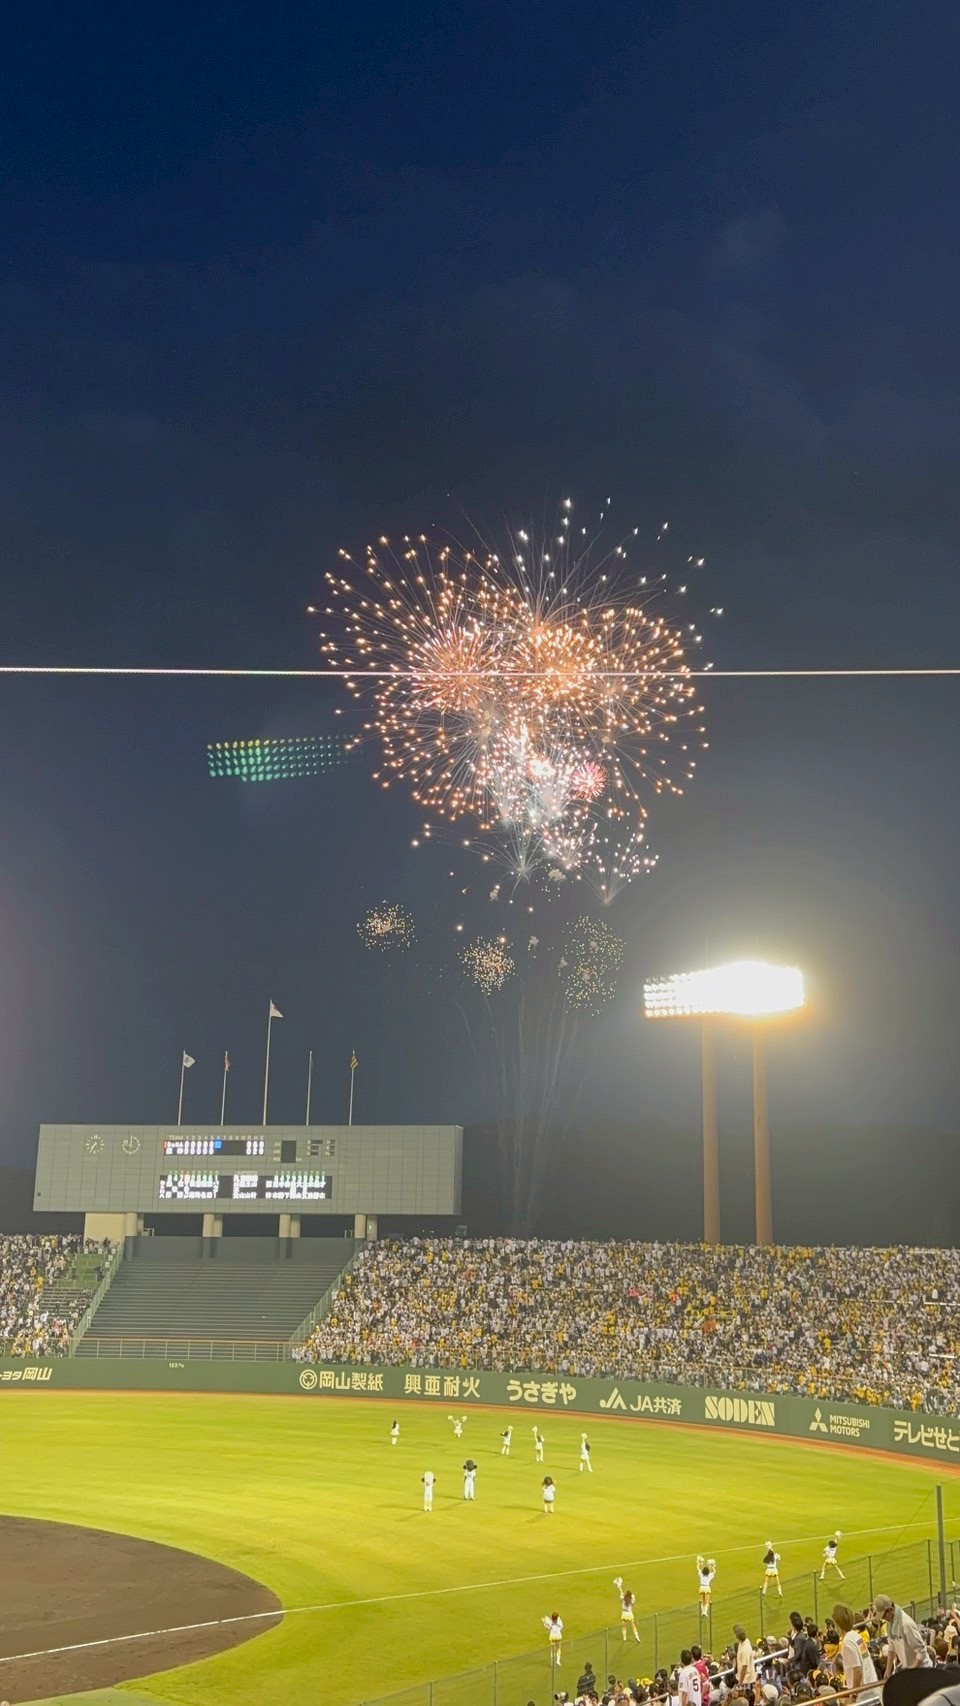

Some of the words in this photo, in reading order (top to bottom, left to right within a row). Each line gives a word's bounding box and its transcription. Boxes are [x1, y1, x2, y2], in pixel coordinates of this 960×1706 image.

[319, 1370, 383, 1392] 岡山製紙
[404, 1374, 480, 1398] 興亜耐火
[507, 1379, 576, 1405] うさぎや
[630, 1395, 682, 1415] JA共済
[704, 1396, 775, 1426] SODEN
[830, 1414, 870, 1429] MITSUBISHI
[830, 1424, 860, 1437] MOTORS
[692, 1678, 699, 1692] 5
